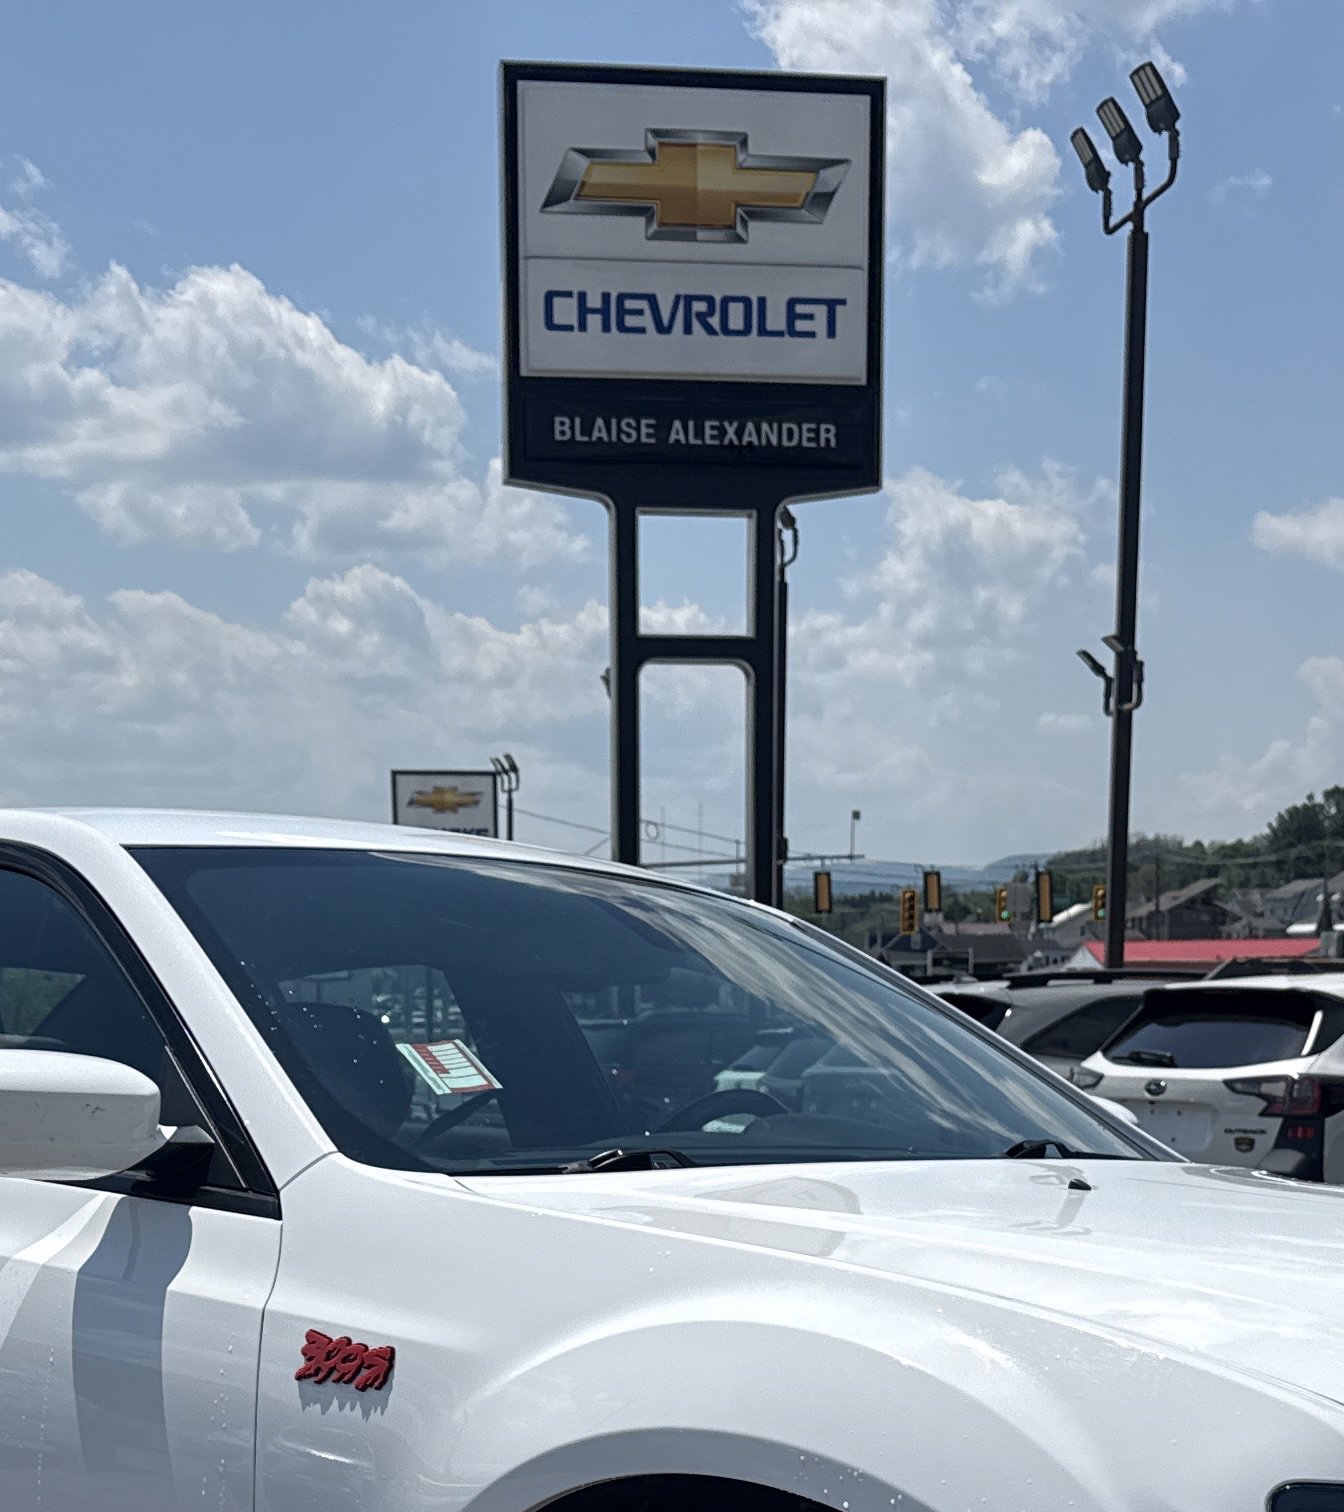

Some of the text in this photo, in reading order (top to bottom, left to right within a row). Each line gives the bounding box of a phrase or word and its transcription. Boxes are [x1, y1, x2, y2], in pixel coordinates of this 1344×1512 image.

[543, 289, 848, 340] CHEVROLET
[553, 416, 838, 449] BLAISE ALEXANDER
